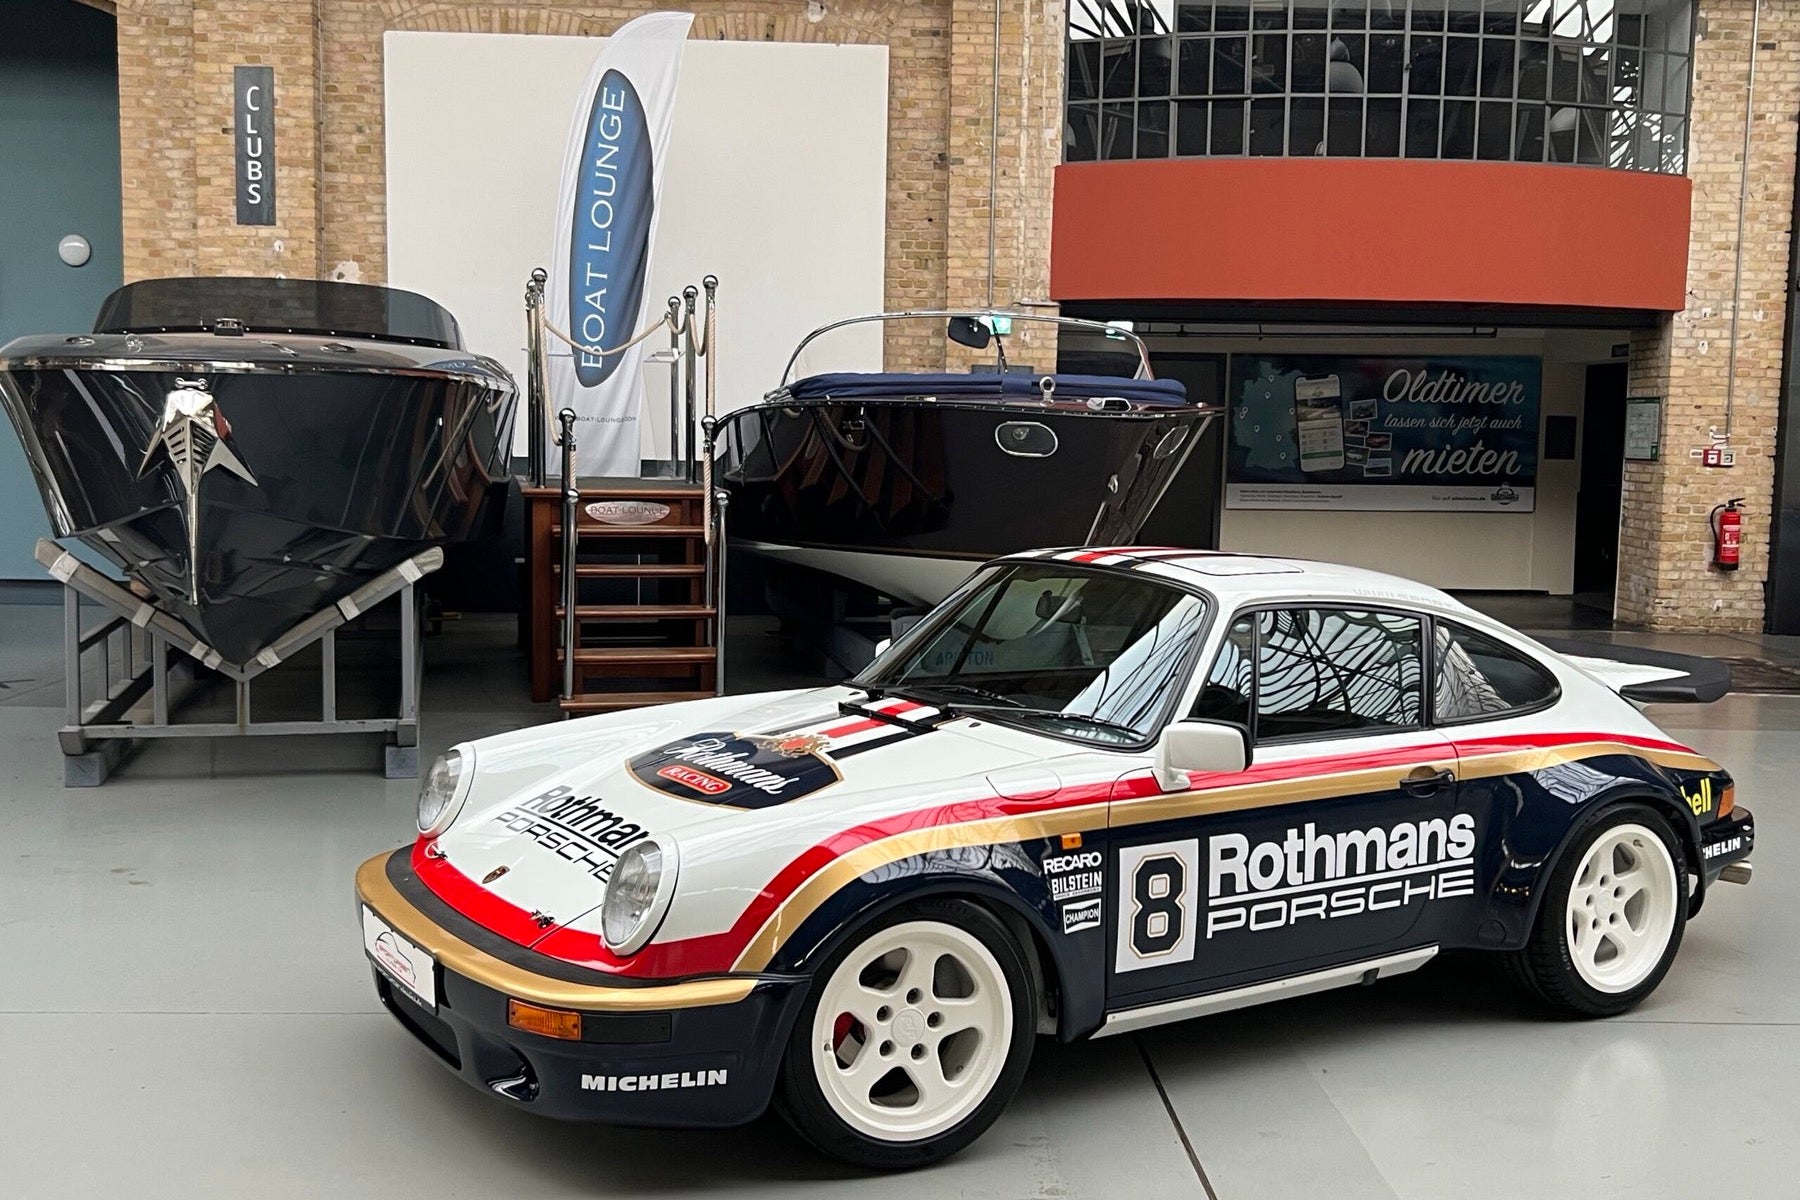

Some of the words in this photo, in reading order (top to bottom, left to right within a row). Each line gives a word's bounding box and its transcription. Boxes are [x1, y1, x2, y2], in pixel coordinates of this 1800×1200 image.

[246, 86, 263, 205] CLUBS
[589, 87, 626, 253] LOUNGE
[581, 262, 608, 369] BOAT
[1383, 368, 1526, 405] Oldtimer
[1384, 413, 1426, 428] lassen
[1429, 413, 1456, 428] sich
[1452, 416, 1488, 436] jetzt
[1490, 415, 1523, 429] auch
[1401, 439, 1522, 476] mieten
[936, 650, 993, 666] ARITON
[659, 738, 800, 795] Rothmans
[665, 767, 724, 792] RACING
[1680, 777, 1712, 816] ell
[521, 785, 650, 851] Rothma
[490, 811, 615, 885] PORSCHE
[1043, 851, 1102, 875] RECARO
[1208, 813, 1475, 898] Rothmans
[1702, 837, 1741, 860] HELIN
[1051, 871, 1102, 895] BILSTEIN
[1065, 908, 1100, 925] CHAMPION
[1129, 852, 1187, 960] 8
[1206, 869, 1475, 939] PORSCHE
[581, 1069, 728, 1092] MICHELIN
